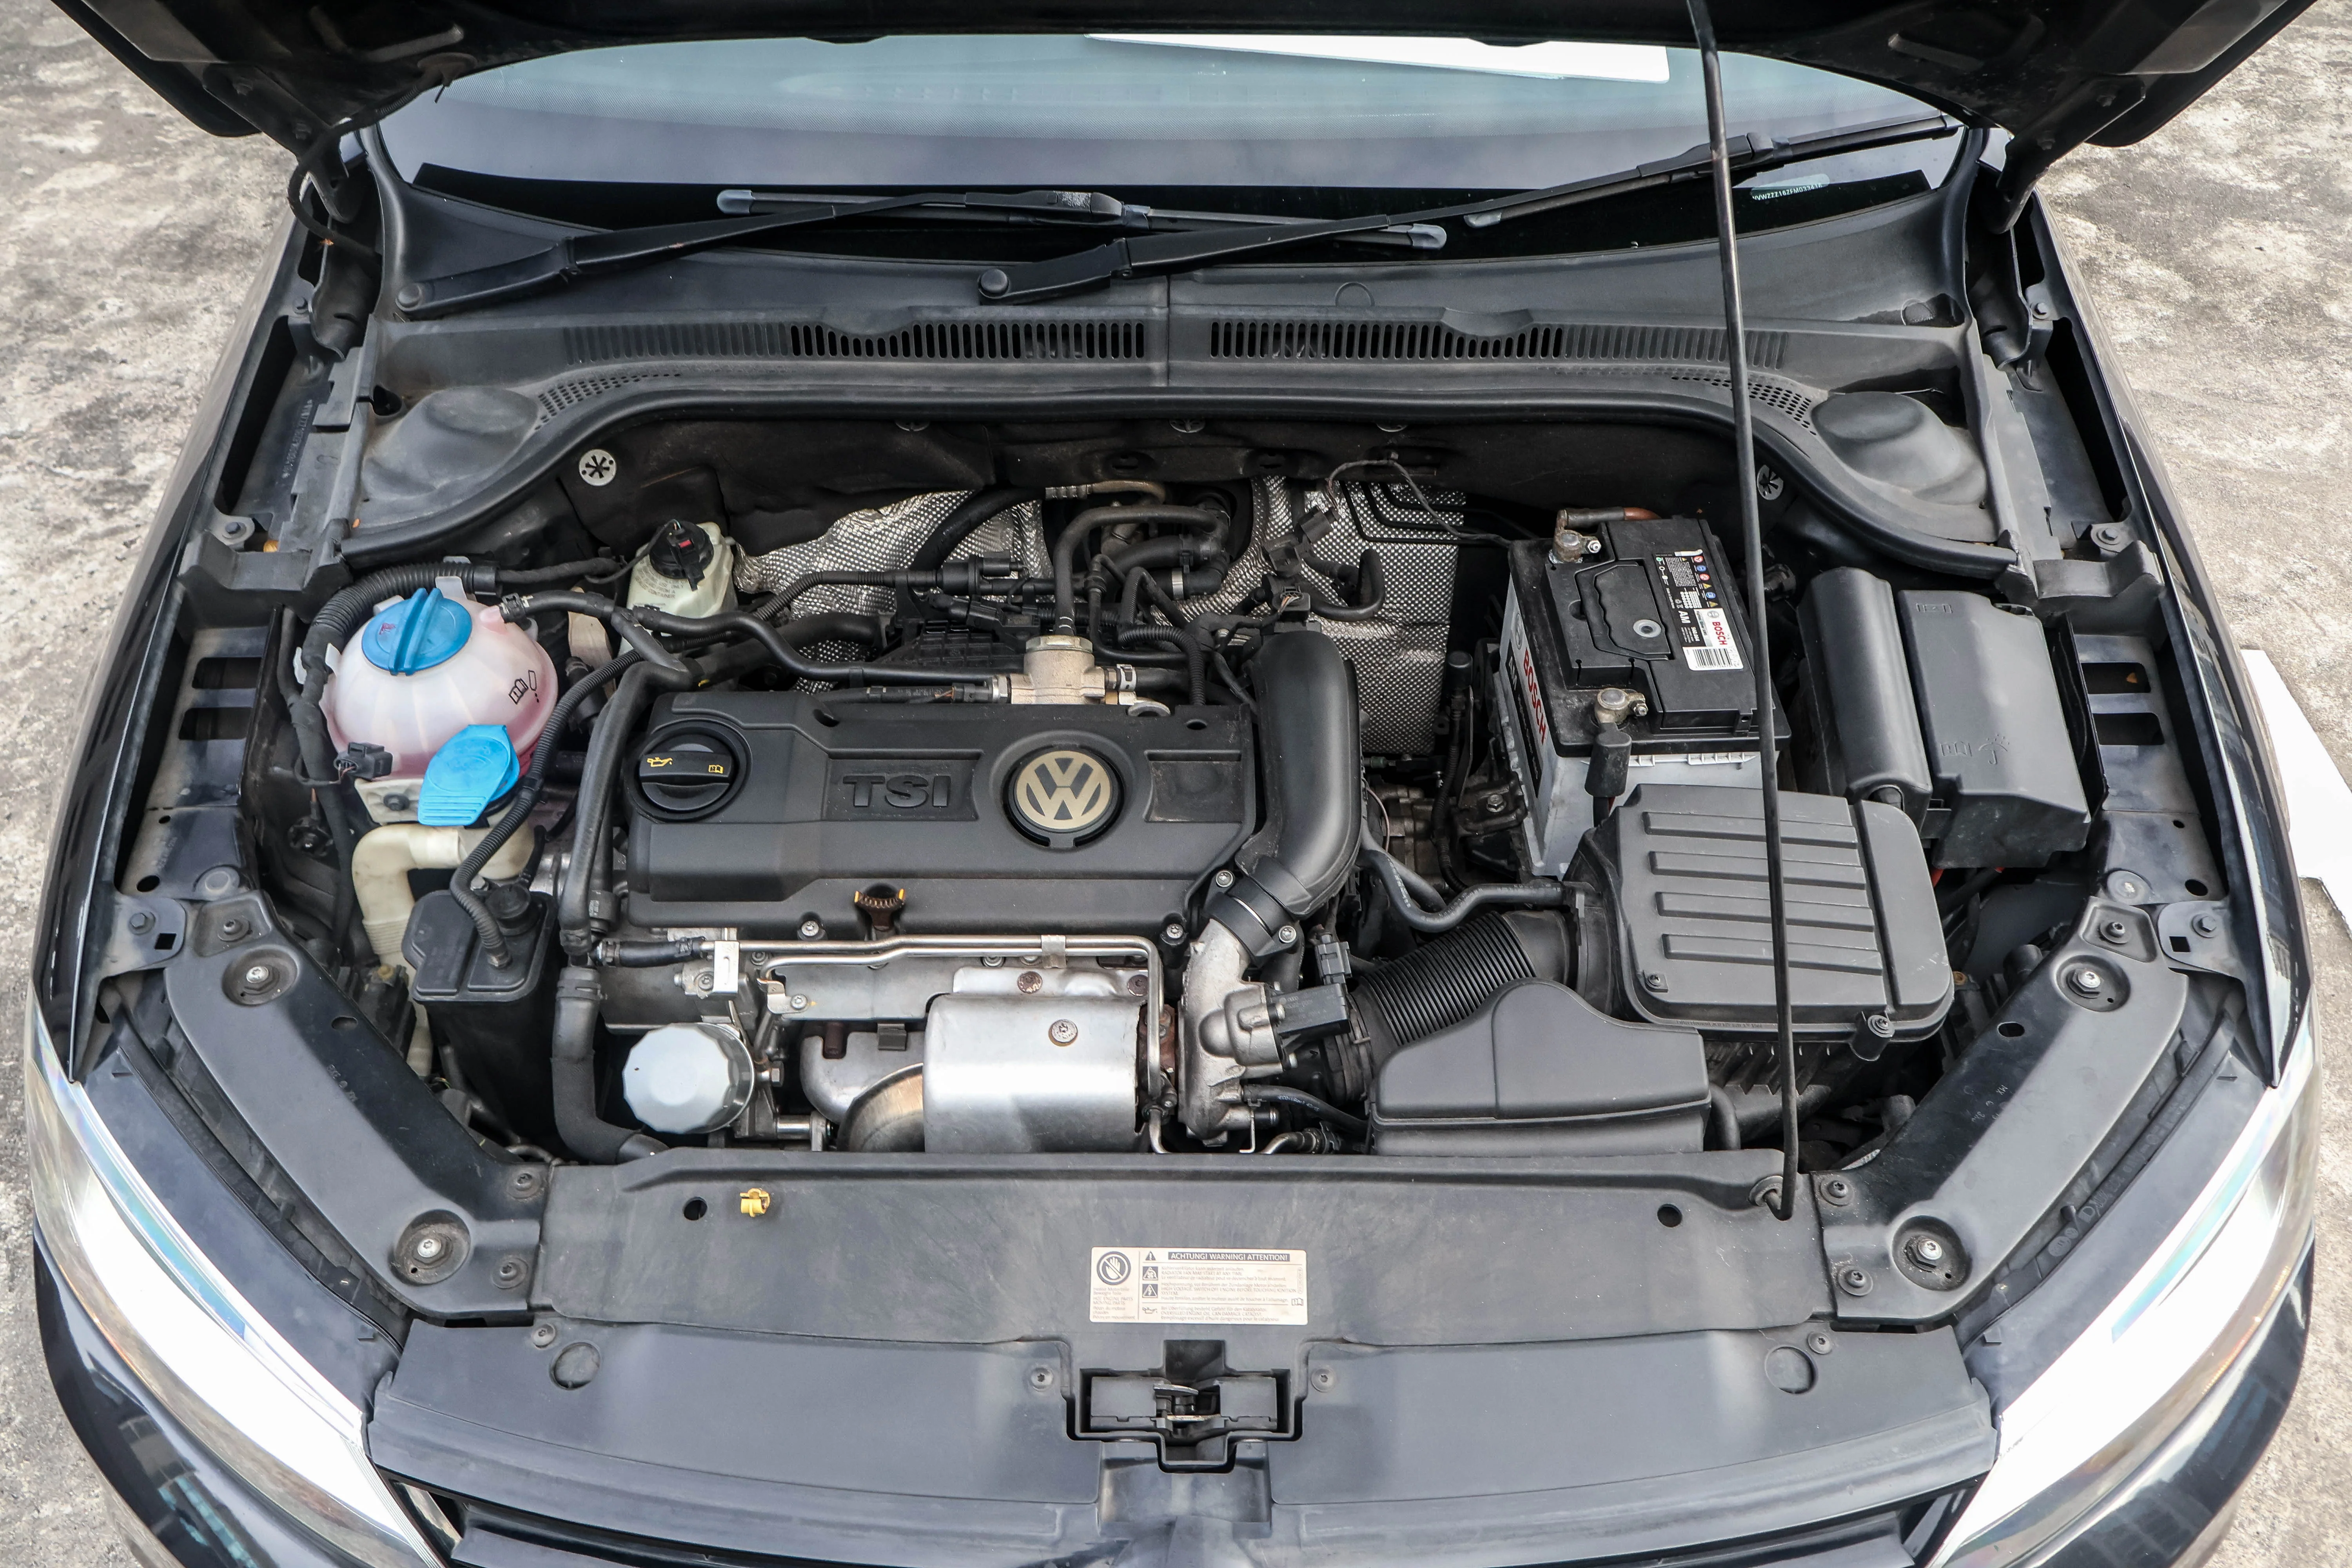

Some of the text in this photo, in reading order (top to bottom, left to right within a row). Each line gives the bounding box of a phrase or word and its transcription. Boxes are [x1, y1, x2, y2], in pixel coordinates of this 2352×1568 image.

[1678, 610, 1691, 623] AM
[1712, 621, 1728, 645] BOSCH
[1508, 656, 1517, 691] AM
[1523, 647, 1546, 746] BOSCH
[843, 775, 952, 807] TSI
[1016, 750, 1110, 829] VW
